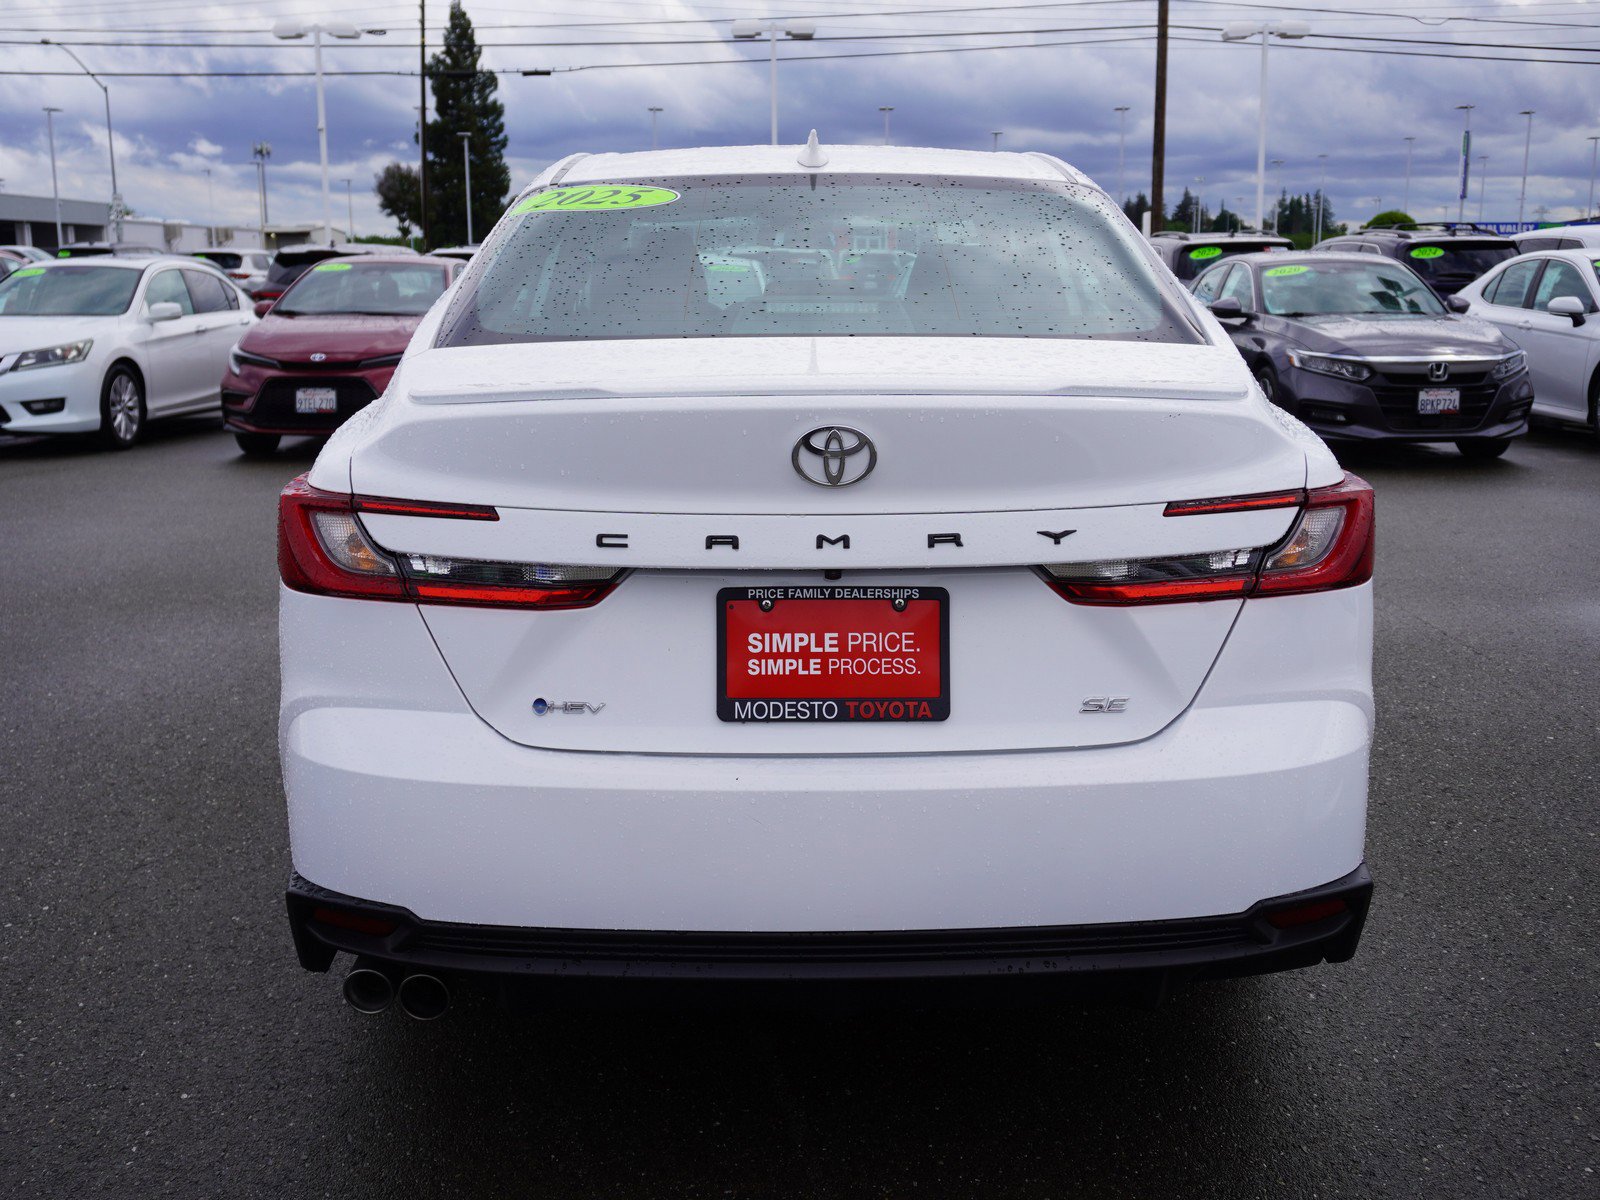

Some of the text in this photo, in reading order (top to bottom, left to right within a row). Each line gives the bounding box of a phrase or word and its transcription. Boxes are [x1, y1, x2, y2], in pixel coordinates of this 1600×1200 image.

[528, 189, 654, 209] 2025
[1500, 223, 1535, 233] VALLEY
[1420, 399, 1458, 411] 8PKP724
[596, 529, 1077, 550] CAMRY
[748, 588, 919, 599] PRICE FAMILY DEALERSHIPS
[747, 632, 921, 653] SIMPLE PRICE.
[747, 658, 922, 675] SIMPLE PROCESS.
[547, 701, 606, 714] HEV
[734, 701, 933, 719] MODESTO TOYOTA
[1079, 697, 1129, 713] SE
